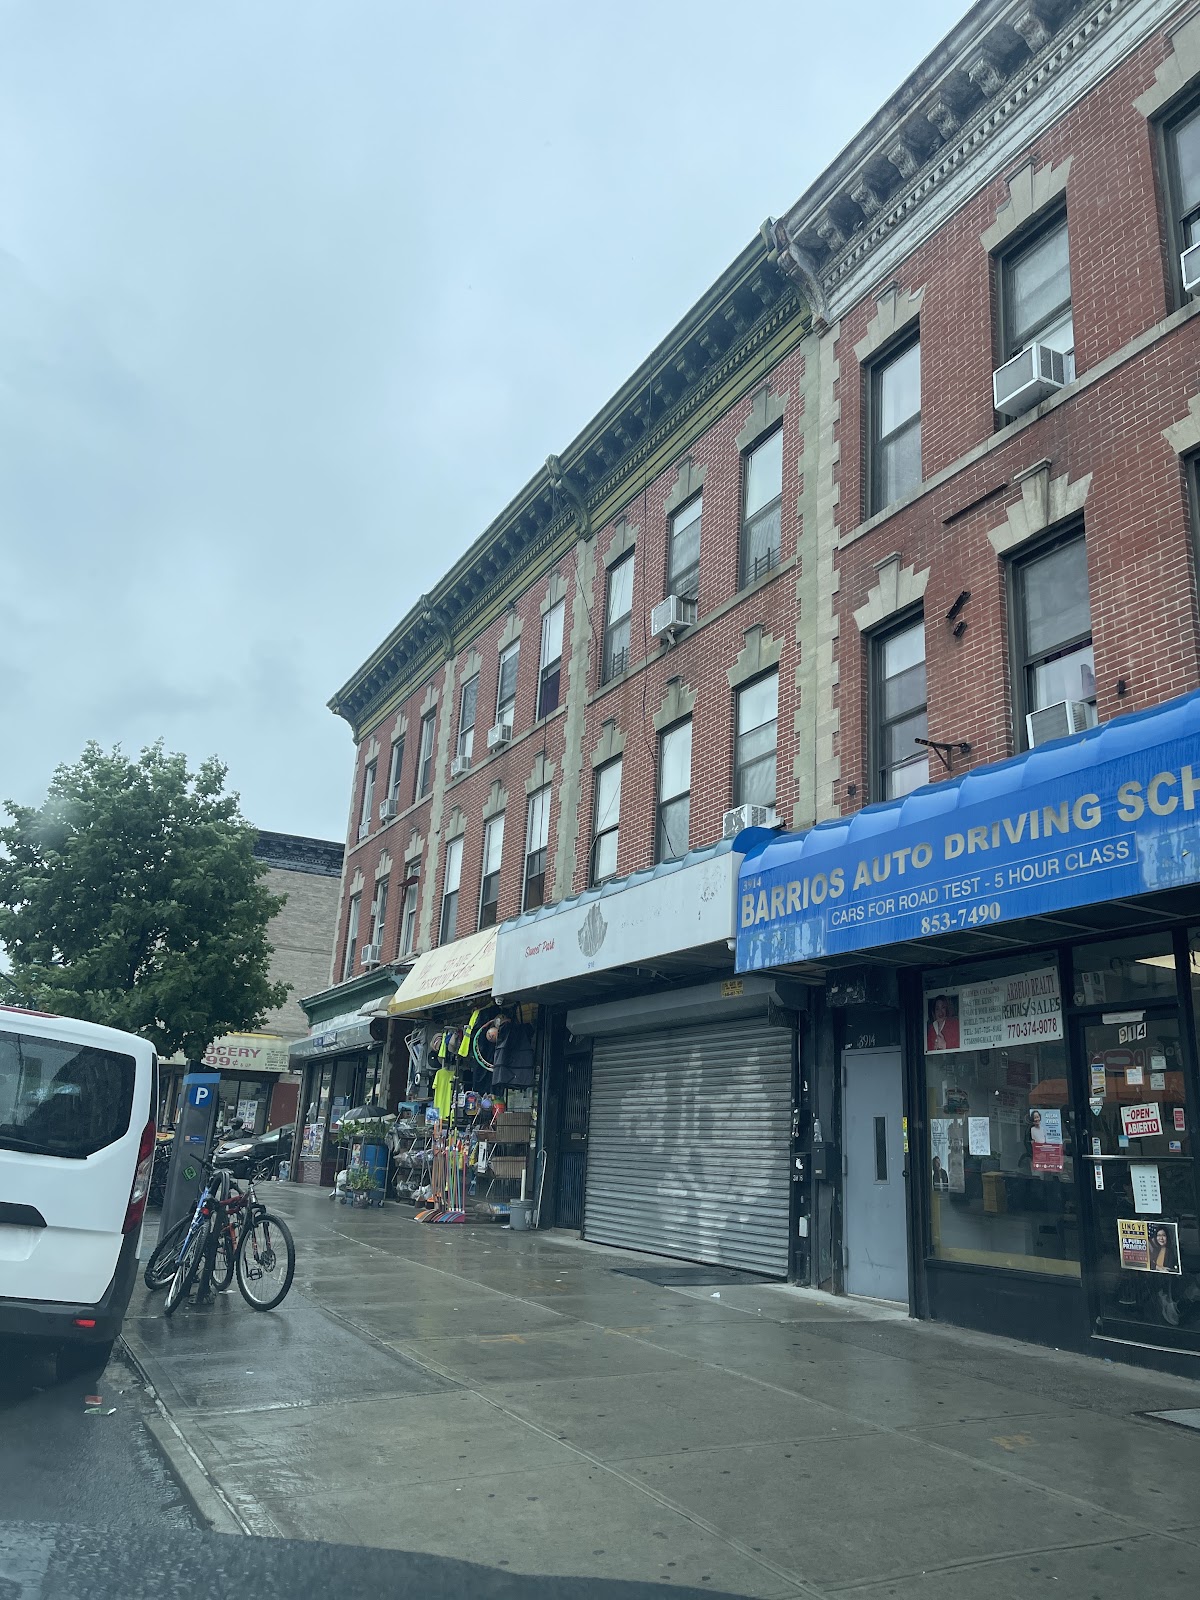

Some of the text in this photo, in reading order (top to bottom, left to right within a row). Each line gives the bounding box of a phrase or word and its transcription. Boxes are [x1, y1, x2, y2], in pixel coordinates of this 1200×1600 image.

[741, 867, 845, 929] BARRIOS
[853, 843, 932, 891] AUTO
[944, 793, 1102, 861] DRIVING
[831, 907, 865, 926] CARS
[868, 900, 895, 918] FOR
[899, 888, 939, 911] ROAD
[943, 877, 981, 900] TEST
[994, 873, 1003, 889] 5
[1009, 858, 1060, 885] HOUR
[1065, 841, 1130, 871] CLASS
[921, 901, 1001, 935] 853-7490
[1007, 1017, 1058, 1039] 770-374-9078
[1119, 1023, 1145, 1042] 914
[195, 1087, 209, 1105] P
[1128, 1121, 1158, 1135] ABIERTO
[1121, 1222, 1145, 1232] LING YE
